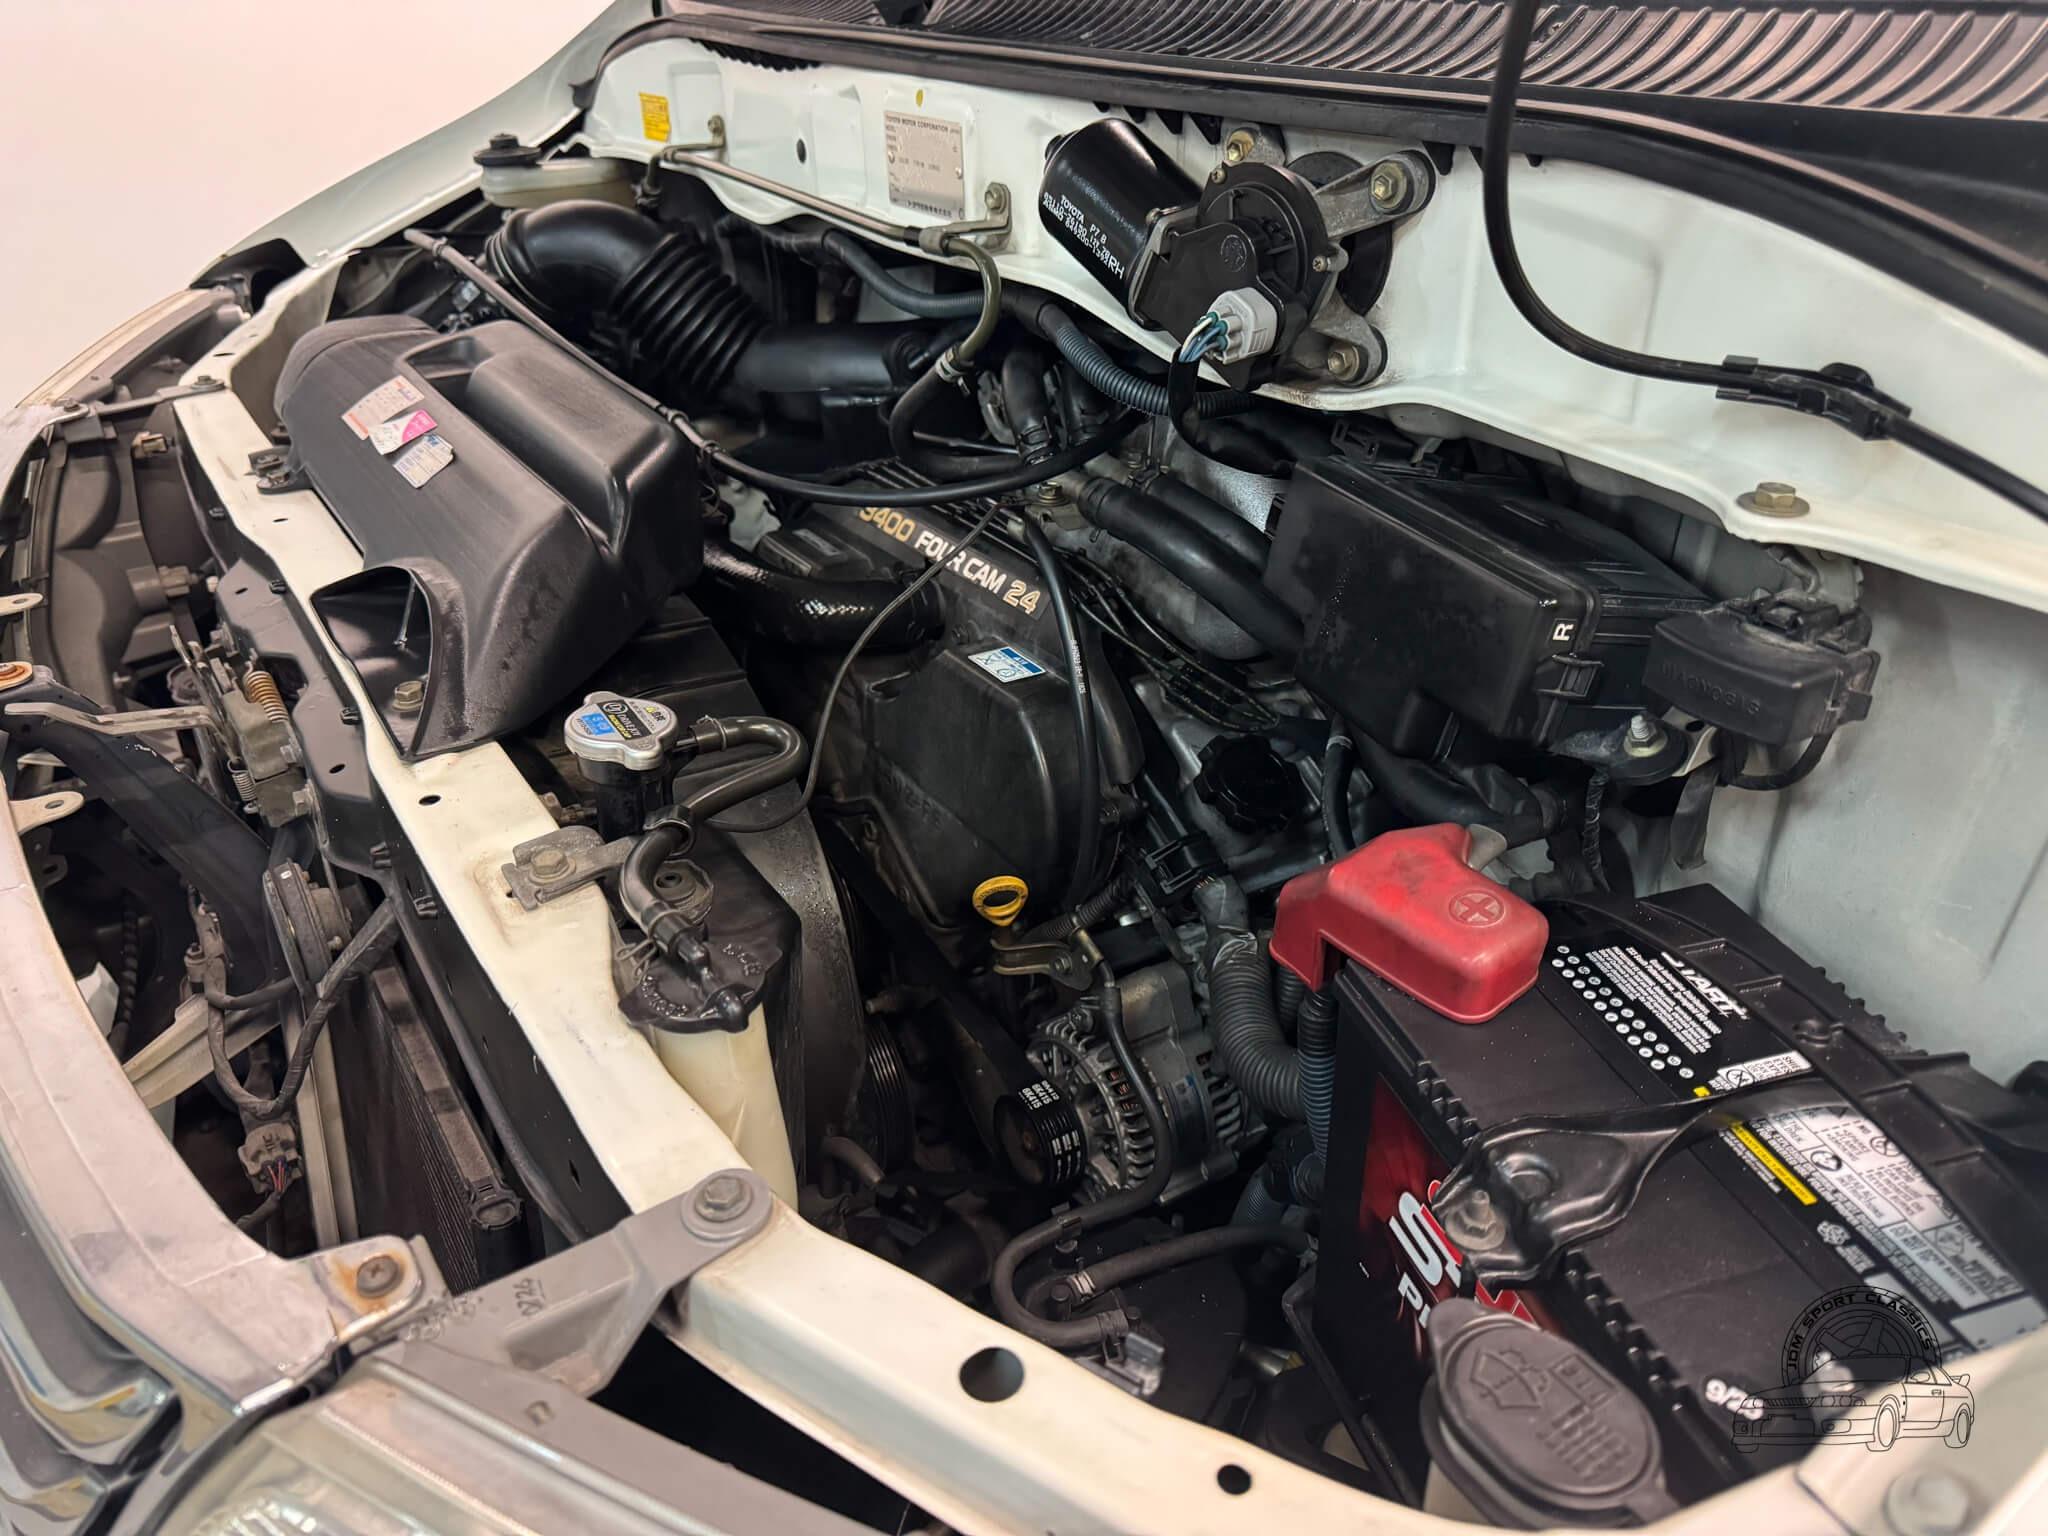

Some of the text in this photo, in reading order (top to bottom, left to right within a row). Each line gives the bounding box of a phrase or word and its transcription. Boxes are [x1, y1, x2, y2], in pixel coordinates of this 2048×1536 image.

[917, 120, 948, 132] CORPORATION
[1061, 194, 1085, 224] TOYOTA
[1108, 255, 1125, 280] RH
[962, 557, 1008, 595] CAM
[1003, 578, 1041, 615] 24
[1553, 623, 1573, 641] R
[1022, 1087, 1042, 1109] 6K415
[1032, 1083, 1053, 1105] 6K415
